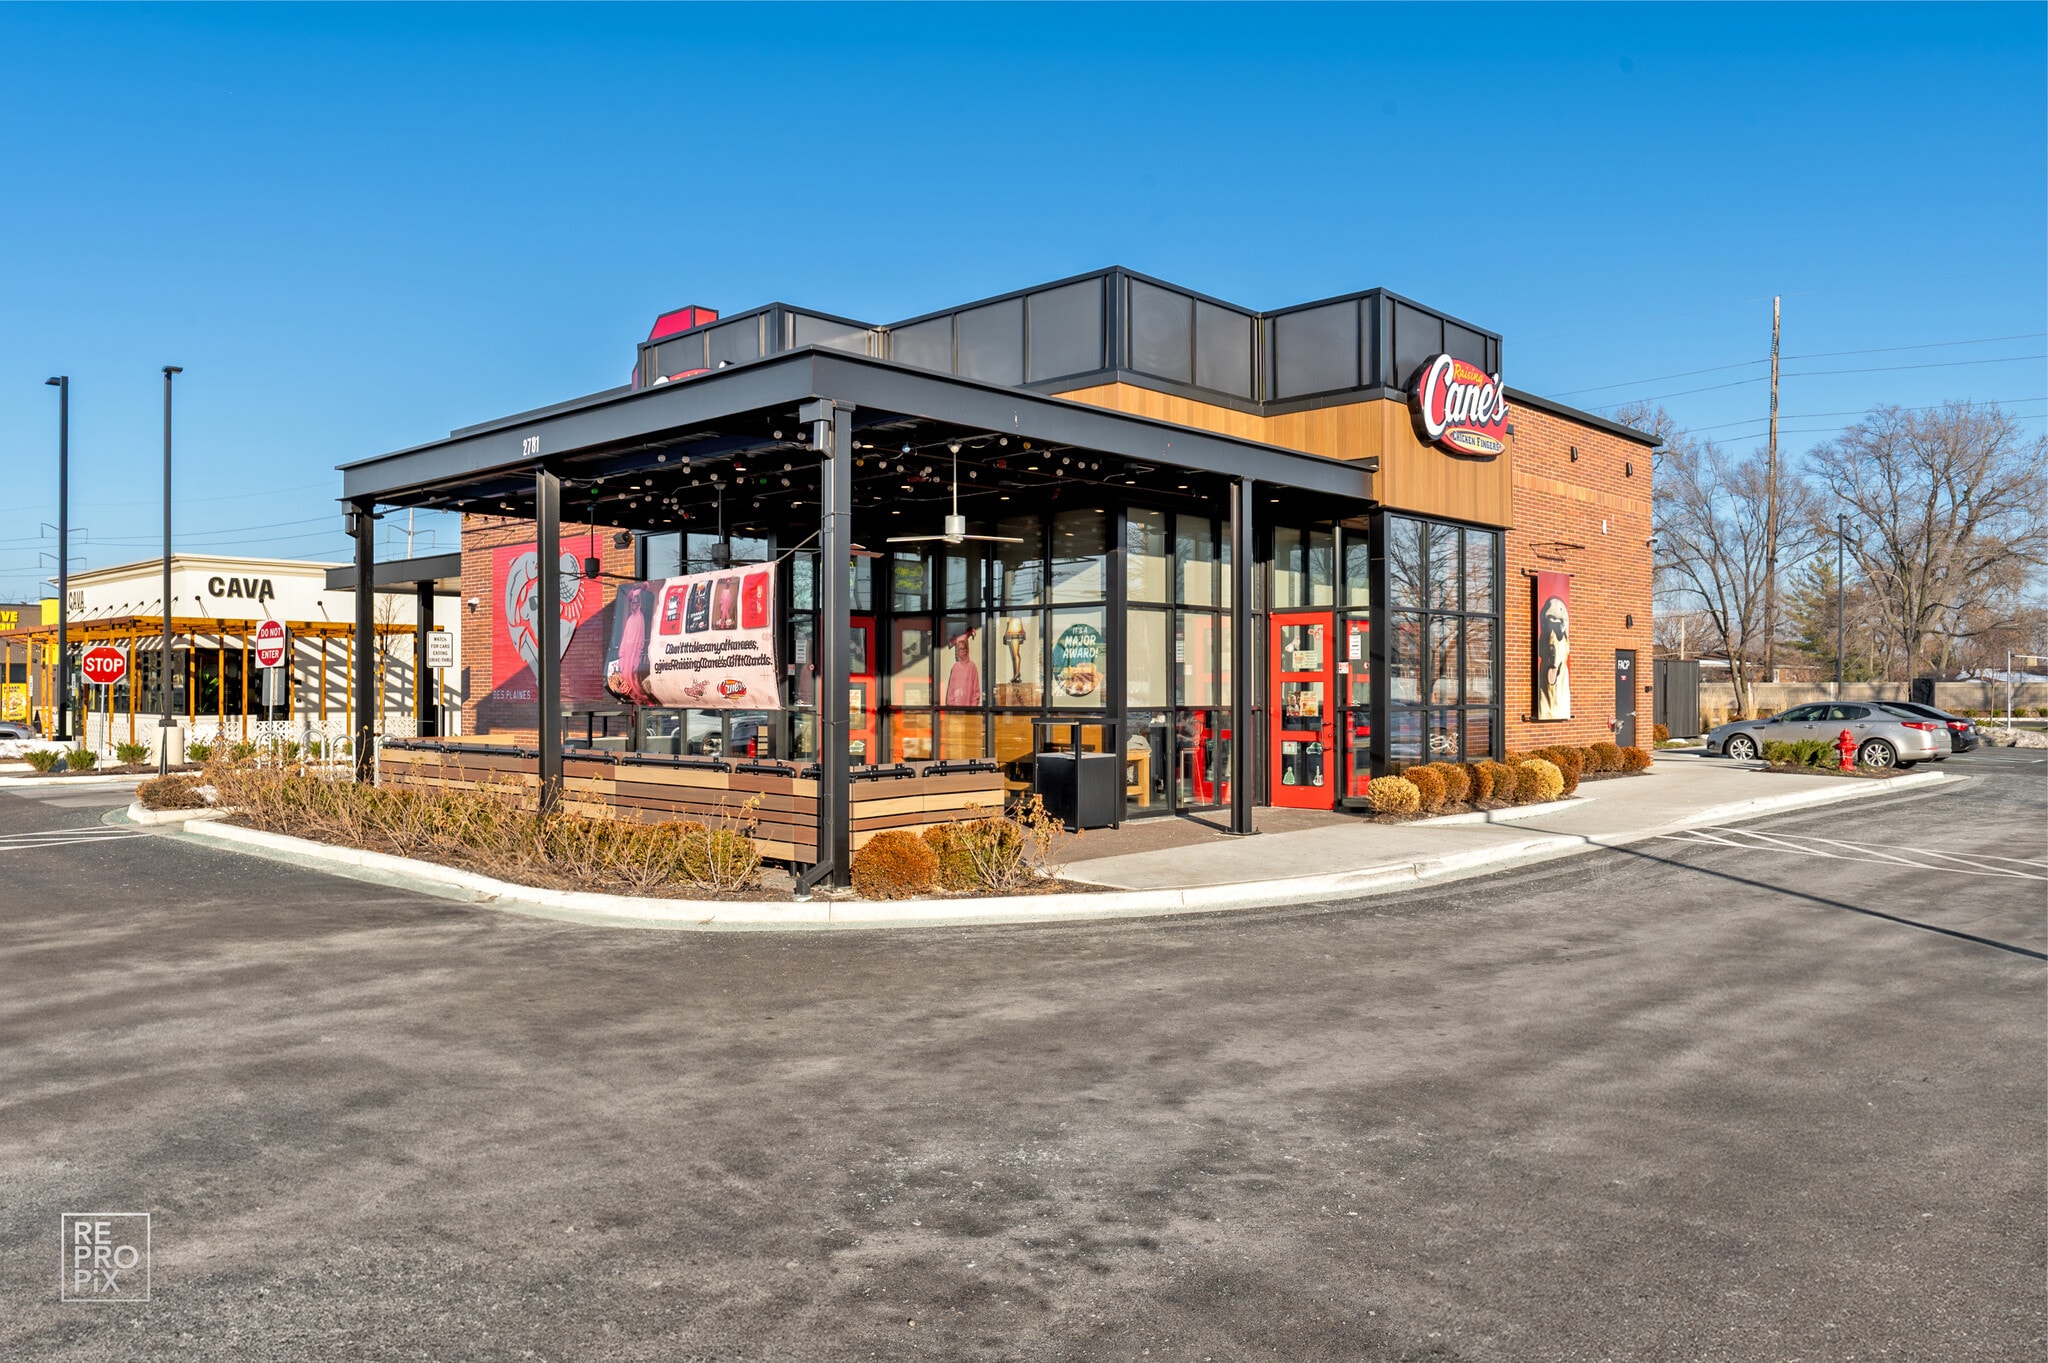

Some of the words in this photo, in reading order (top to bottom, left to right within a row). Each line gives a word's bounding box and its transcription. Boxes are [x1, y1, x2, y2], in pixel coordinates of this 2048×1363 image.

[1454, 363, 1483, 387] Raising
[1424, 353, 1509, 437] Cane's
[522, 435, 540, 456] 2781
[1453, 431, 1476, 446] CHICKEN
[1477, 437, 1500, 451] FINGERS
[208, 576, 275, 600] CAVA
[68, 590, 85, 610] CAVA
[261, 629, 269, 637] DO
[270, 628, 281, 637] NOT
[1065, 635, 1097, 648] MAJOR
[262, 650, 280, 659] ENTER
[1063, 648, 1099, 659] AWARD!
[85, 657, 124, 673] STOP
[493, 690, 504, 699] DES
[506, 690, 531, 699] PLAINES
